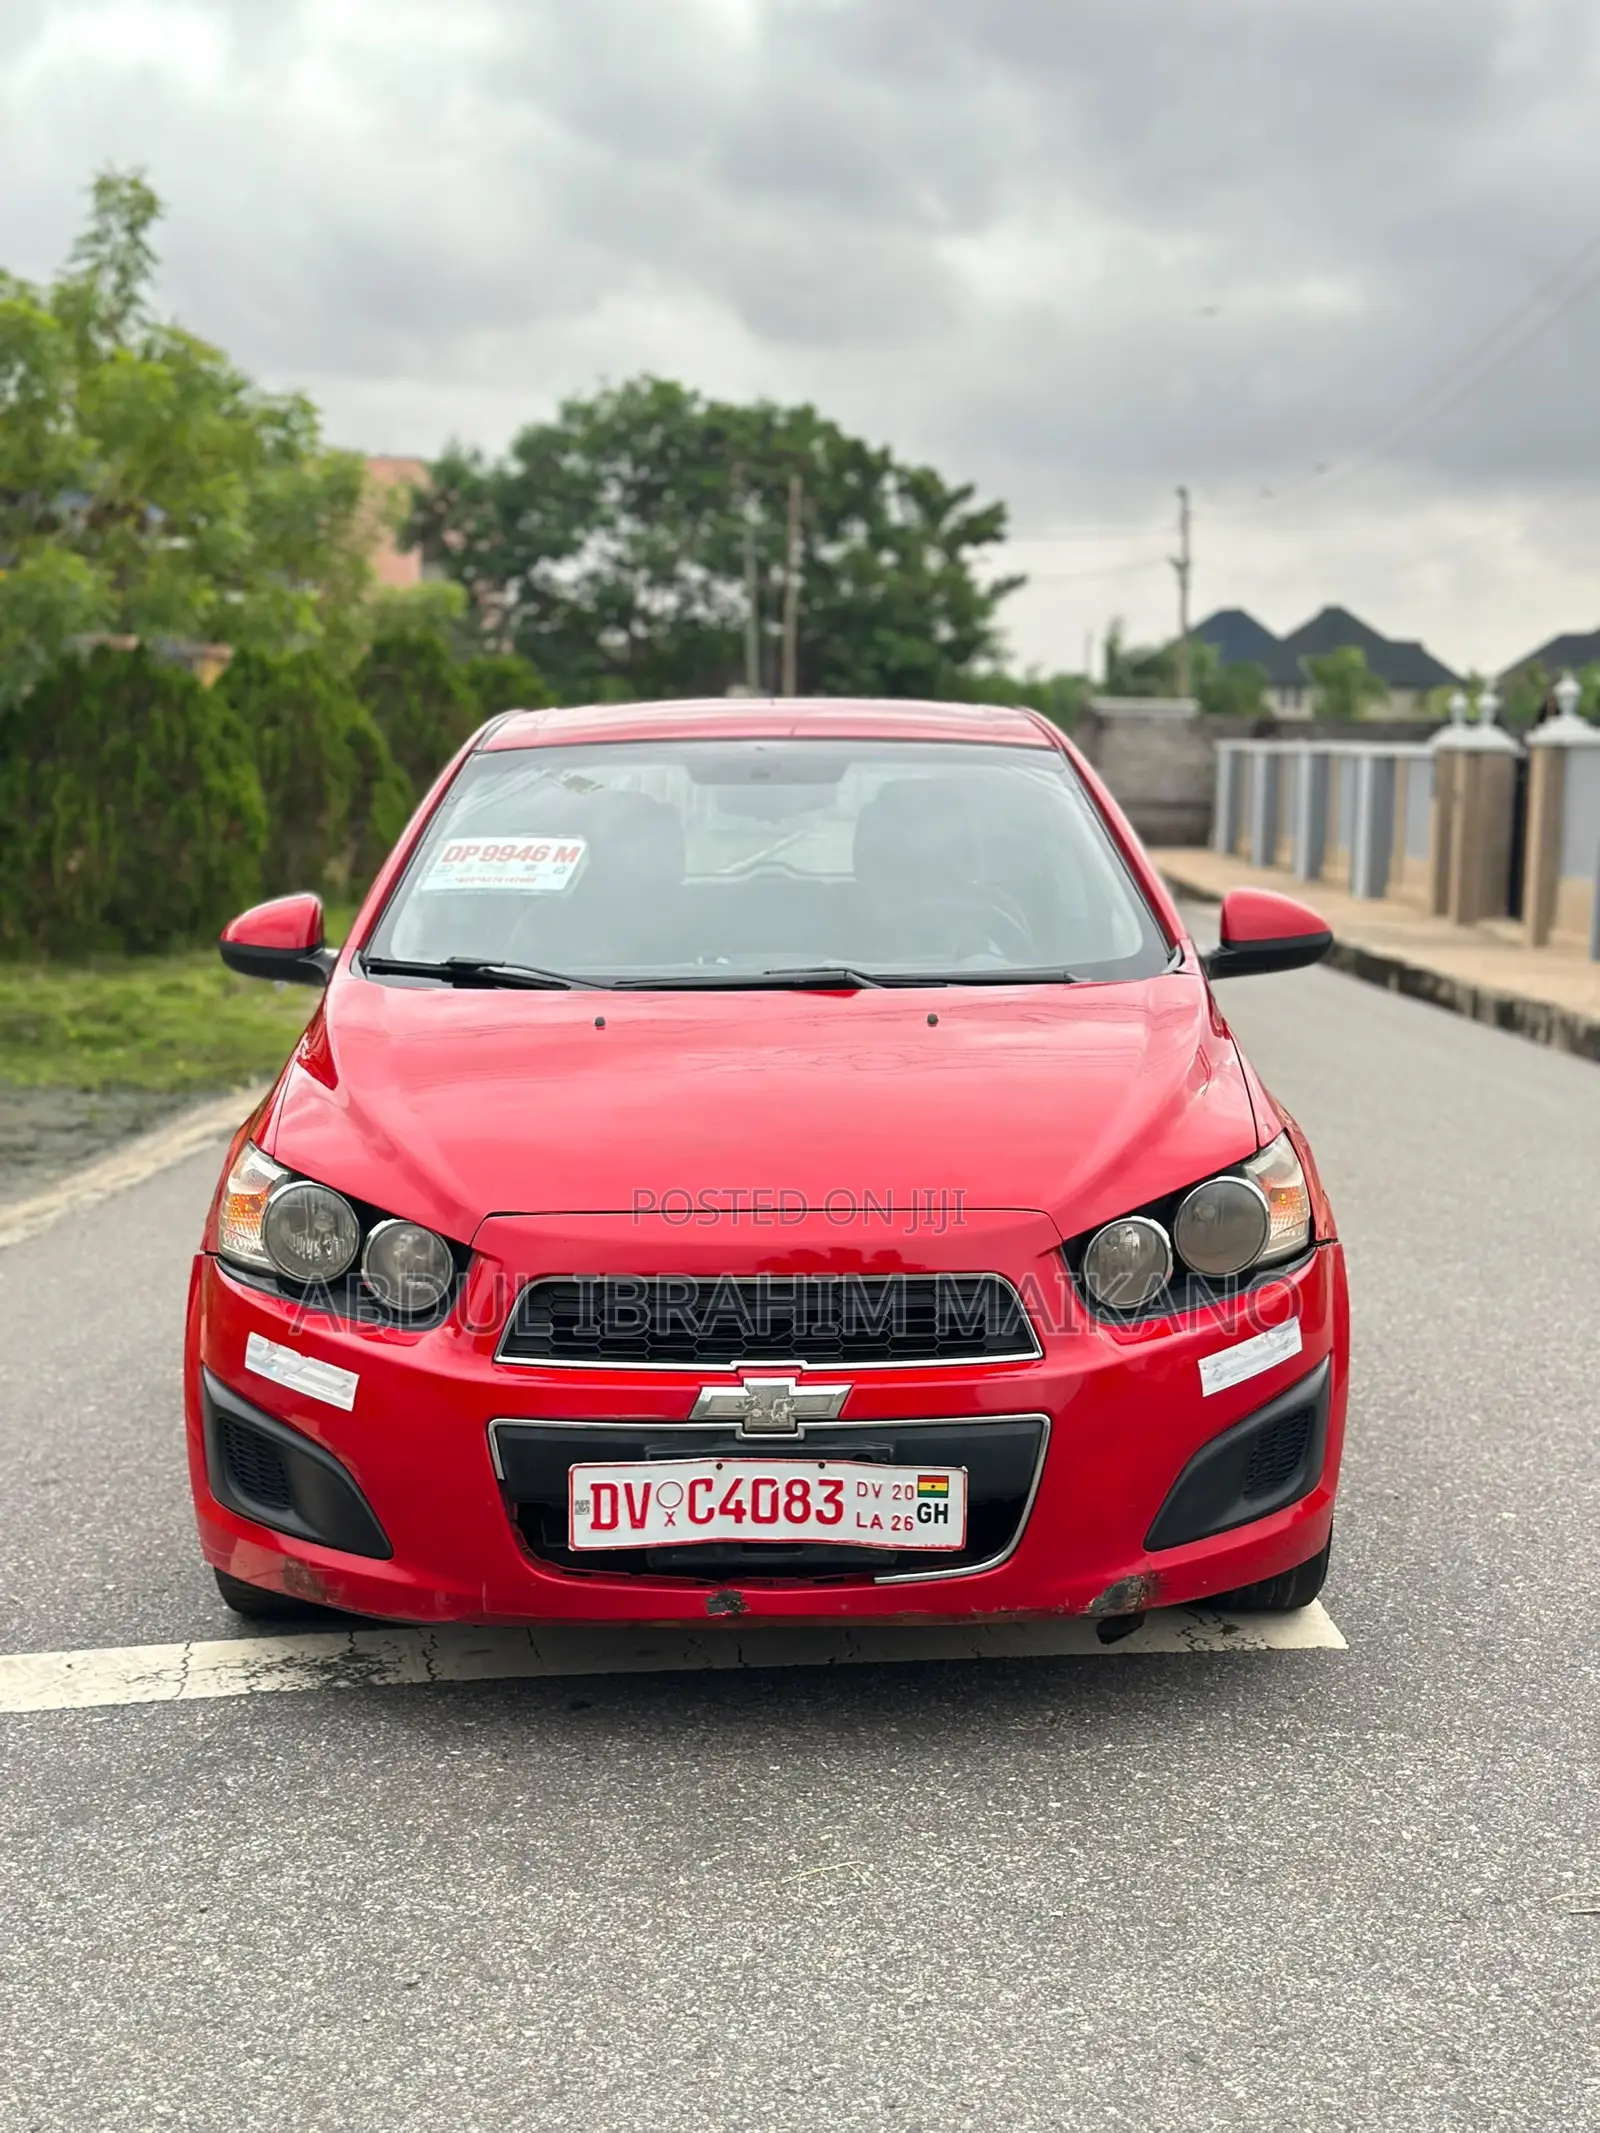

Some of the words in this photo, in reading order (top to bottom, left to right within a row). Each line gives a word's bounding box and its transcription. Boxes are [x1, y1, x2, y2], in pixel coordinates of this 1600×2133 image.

[552, 846, 582, 863] M
[856, 1481, 883, 1498] DV
[892, 1484, 914, 1501] 20
[590, 1481, 653, 1530] DV
[688, 1477, 845, 1526] C4083
[664, 1511, 676, 1527] X
[856, 1512, 884, 1530] LA
[891, 1514, 914, 1531] 26
[917, 1502, 949, 1525] GH
